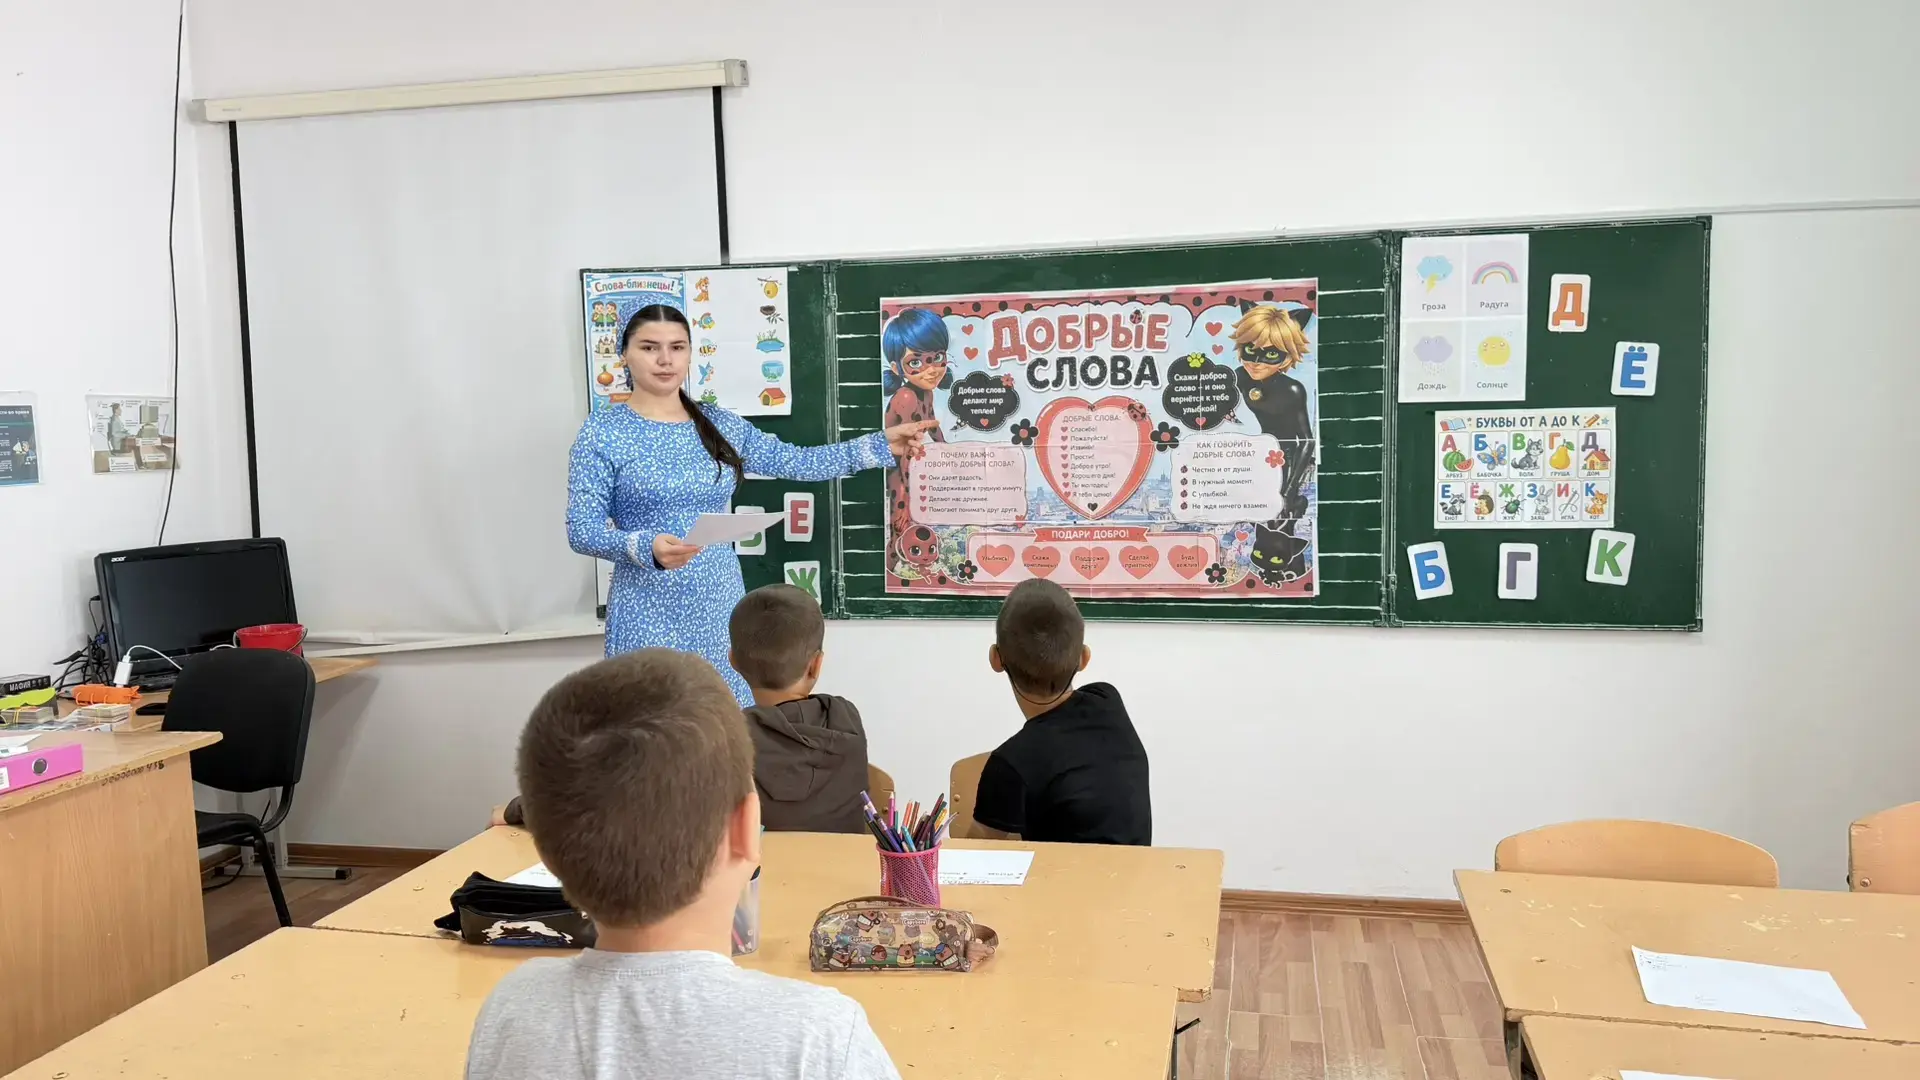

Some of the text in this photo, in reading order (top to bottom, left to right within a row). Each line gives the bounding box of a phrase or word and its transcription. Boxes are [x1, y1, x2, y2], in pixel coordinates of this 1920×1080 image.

[595, 278, 675, 293] Слова-близнецы!
[1422, 304, 1446, 312] Гроза
[1480, 301, 1509, 310] Радуга
[1552, 283, 1584, 327] Д
[988, 314, 1170, 366] ДОБРЫЕ
[1026, 355, 1160, 390] СЛОВА
[1620, 346, 1648, 389] Ё
[1200, 372, 1227, 382] доброе
[958, 386, 984, 396] Добрые
[1417, 382, 1446, 391] Дождь
[1476, 382, 1508, 390] Солнце
[1170, 395, 1204, 404] вернётся
[1183, 405, 1217, 414] улыбкой!
[1476, 415, 1580, 428] БУКВЫ ОТ А ДО К
[1442, 434, 1456, 451] А
[1474, 434, 1488, 451] Б
[1512, 433, 1526, 450] В
[1549, 432, 1561, 449] Г
[1581, 432, 1599, 451] Д
[1193, 451, 1224, 459] ДОБРЫЕ
[1442, 485, 1451, 498] Е
[1470, 483, 1480, 498] Ё
[1499, 484, 1515, 497] Ж
[1527, 483, 1538, 498] З
[1557, 483, 1569, 497] И
[1585, 483, 1596, 496] К
[790, 500, 809, 534] Е
[1052, 530, 1129, 541] ПОДАРИ ДОБРО!
[1594, 538, 1627, 578] К
[1414, 550, 1445, 591] Б
[1506, 552, 1531, 590] Г
[787, 567, 818, 599] Ж
[9, 680, 31, 692] МАФИЯ
